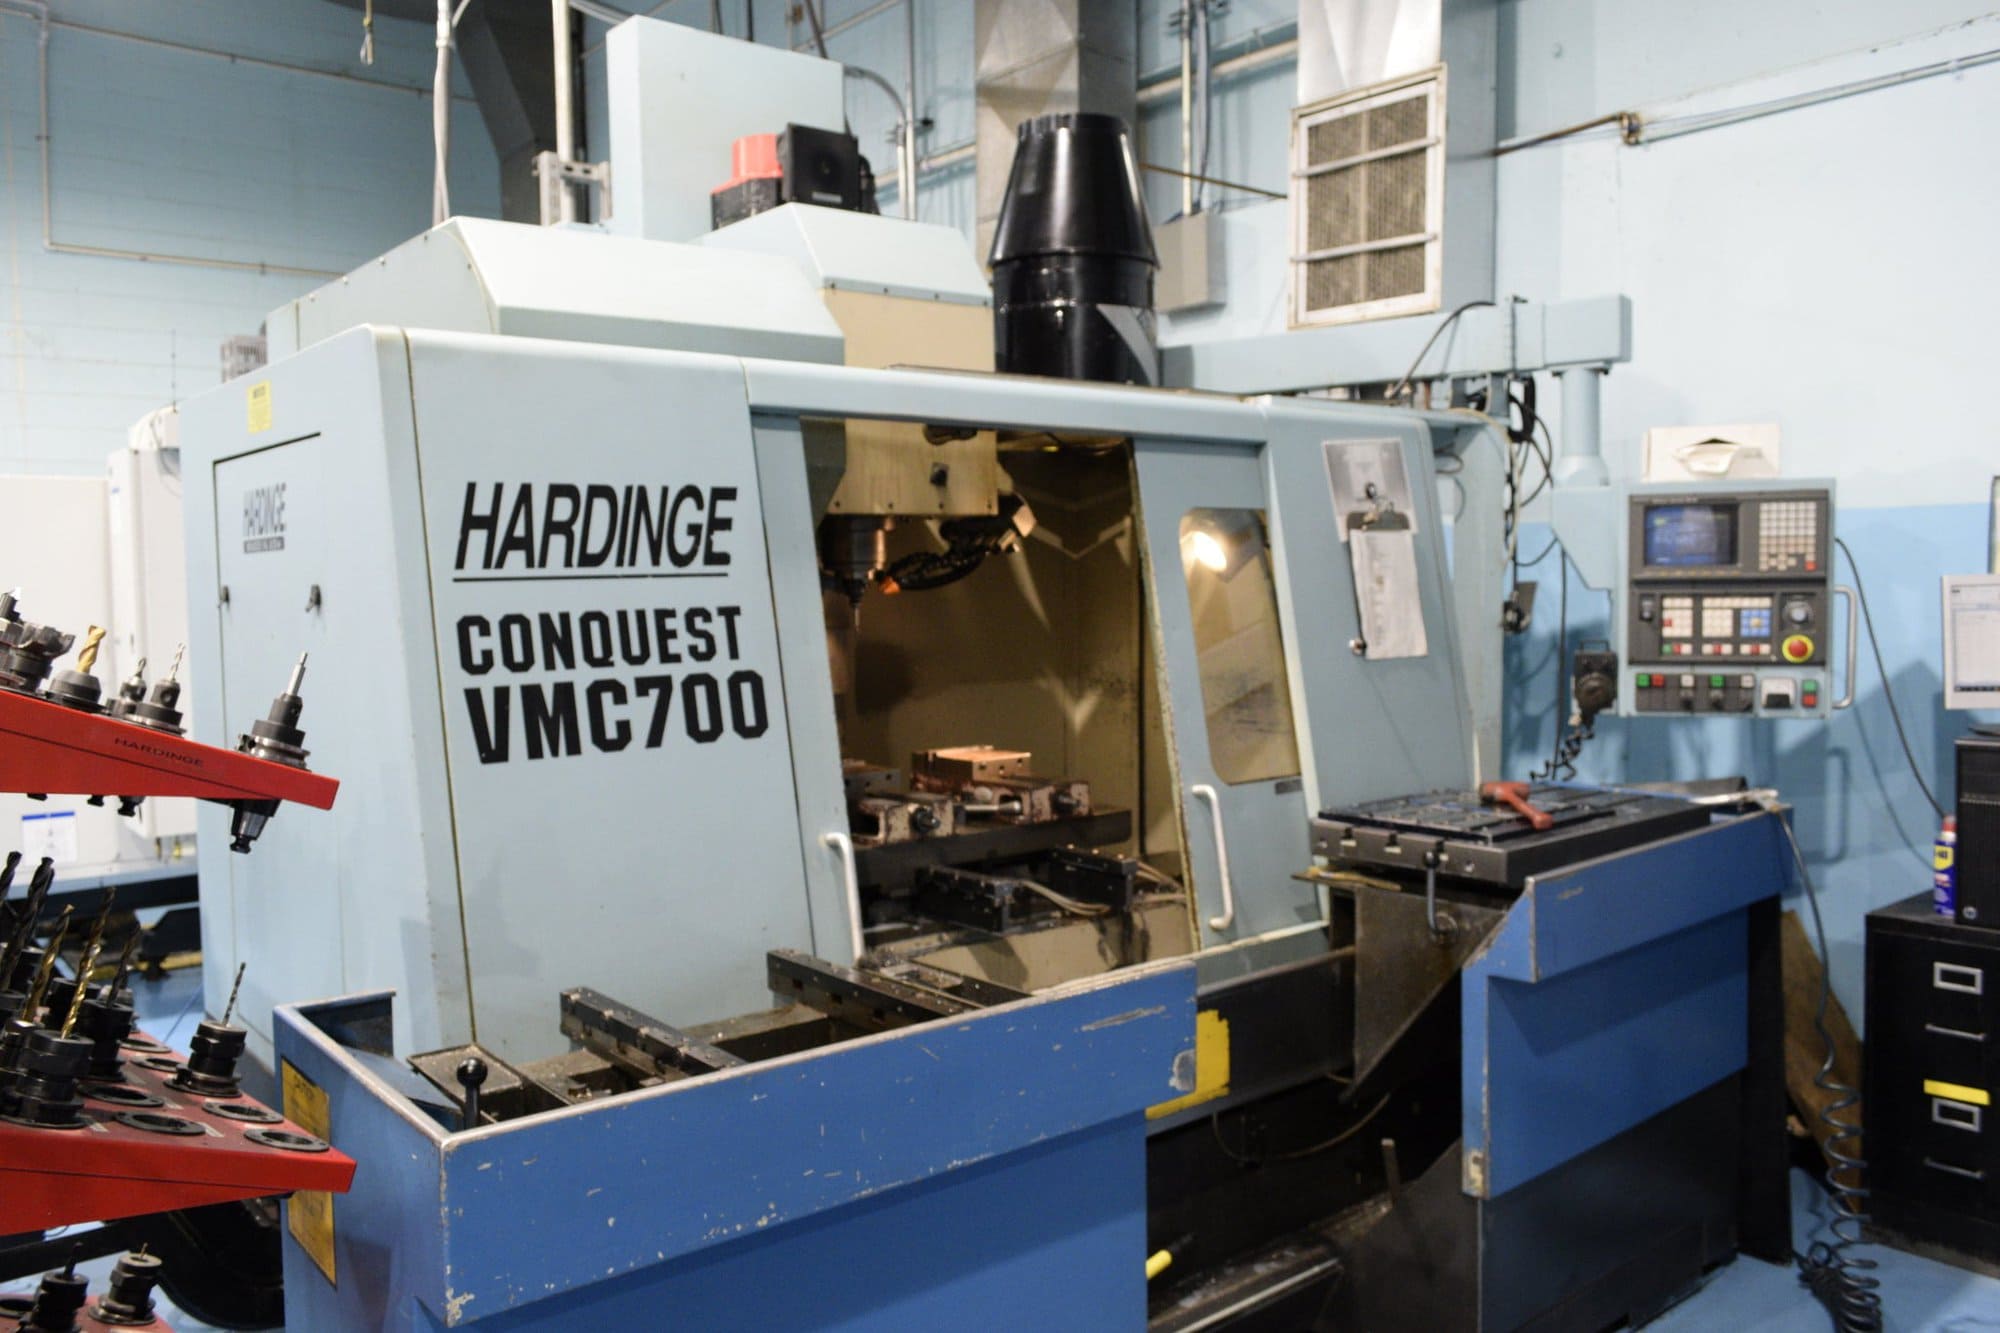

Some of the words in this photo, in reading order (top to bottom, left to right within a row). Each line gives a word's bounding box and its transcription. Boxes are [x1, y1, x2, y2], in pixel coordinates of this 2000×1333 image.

[455, 482, 738, 570] HARDINGE
[456, 606, 742, 675] CONQUEST
[114, 737, 204, 767] HARDINGE
[463, 669, 769, 764] VMC700
